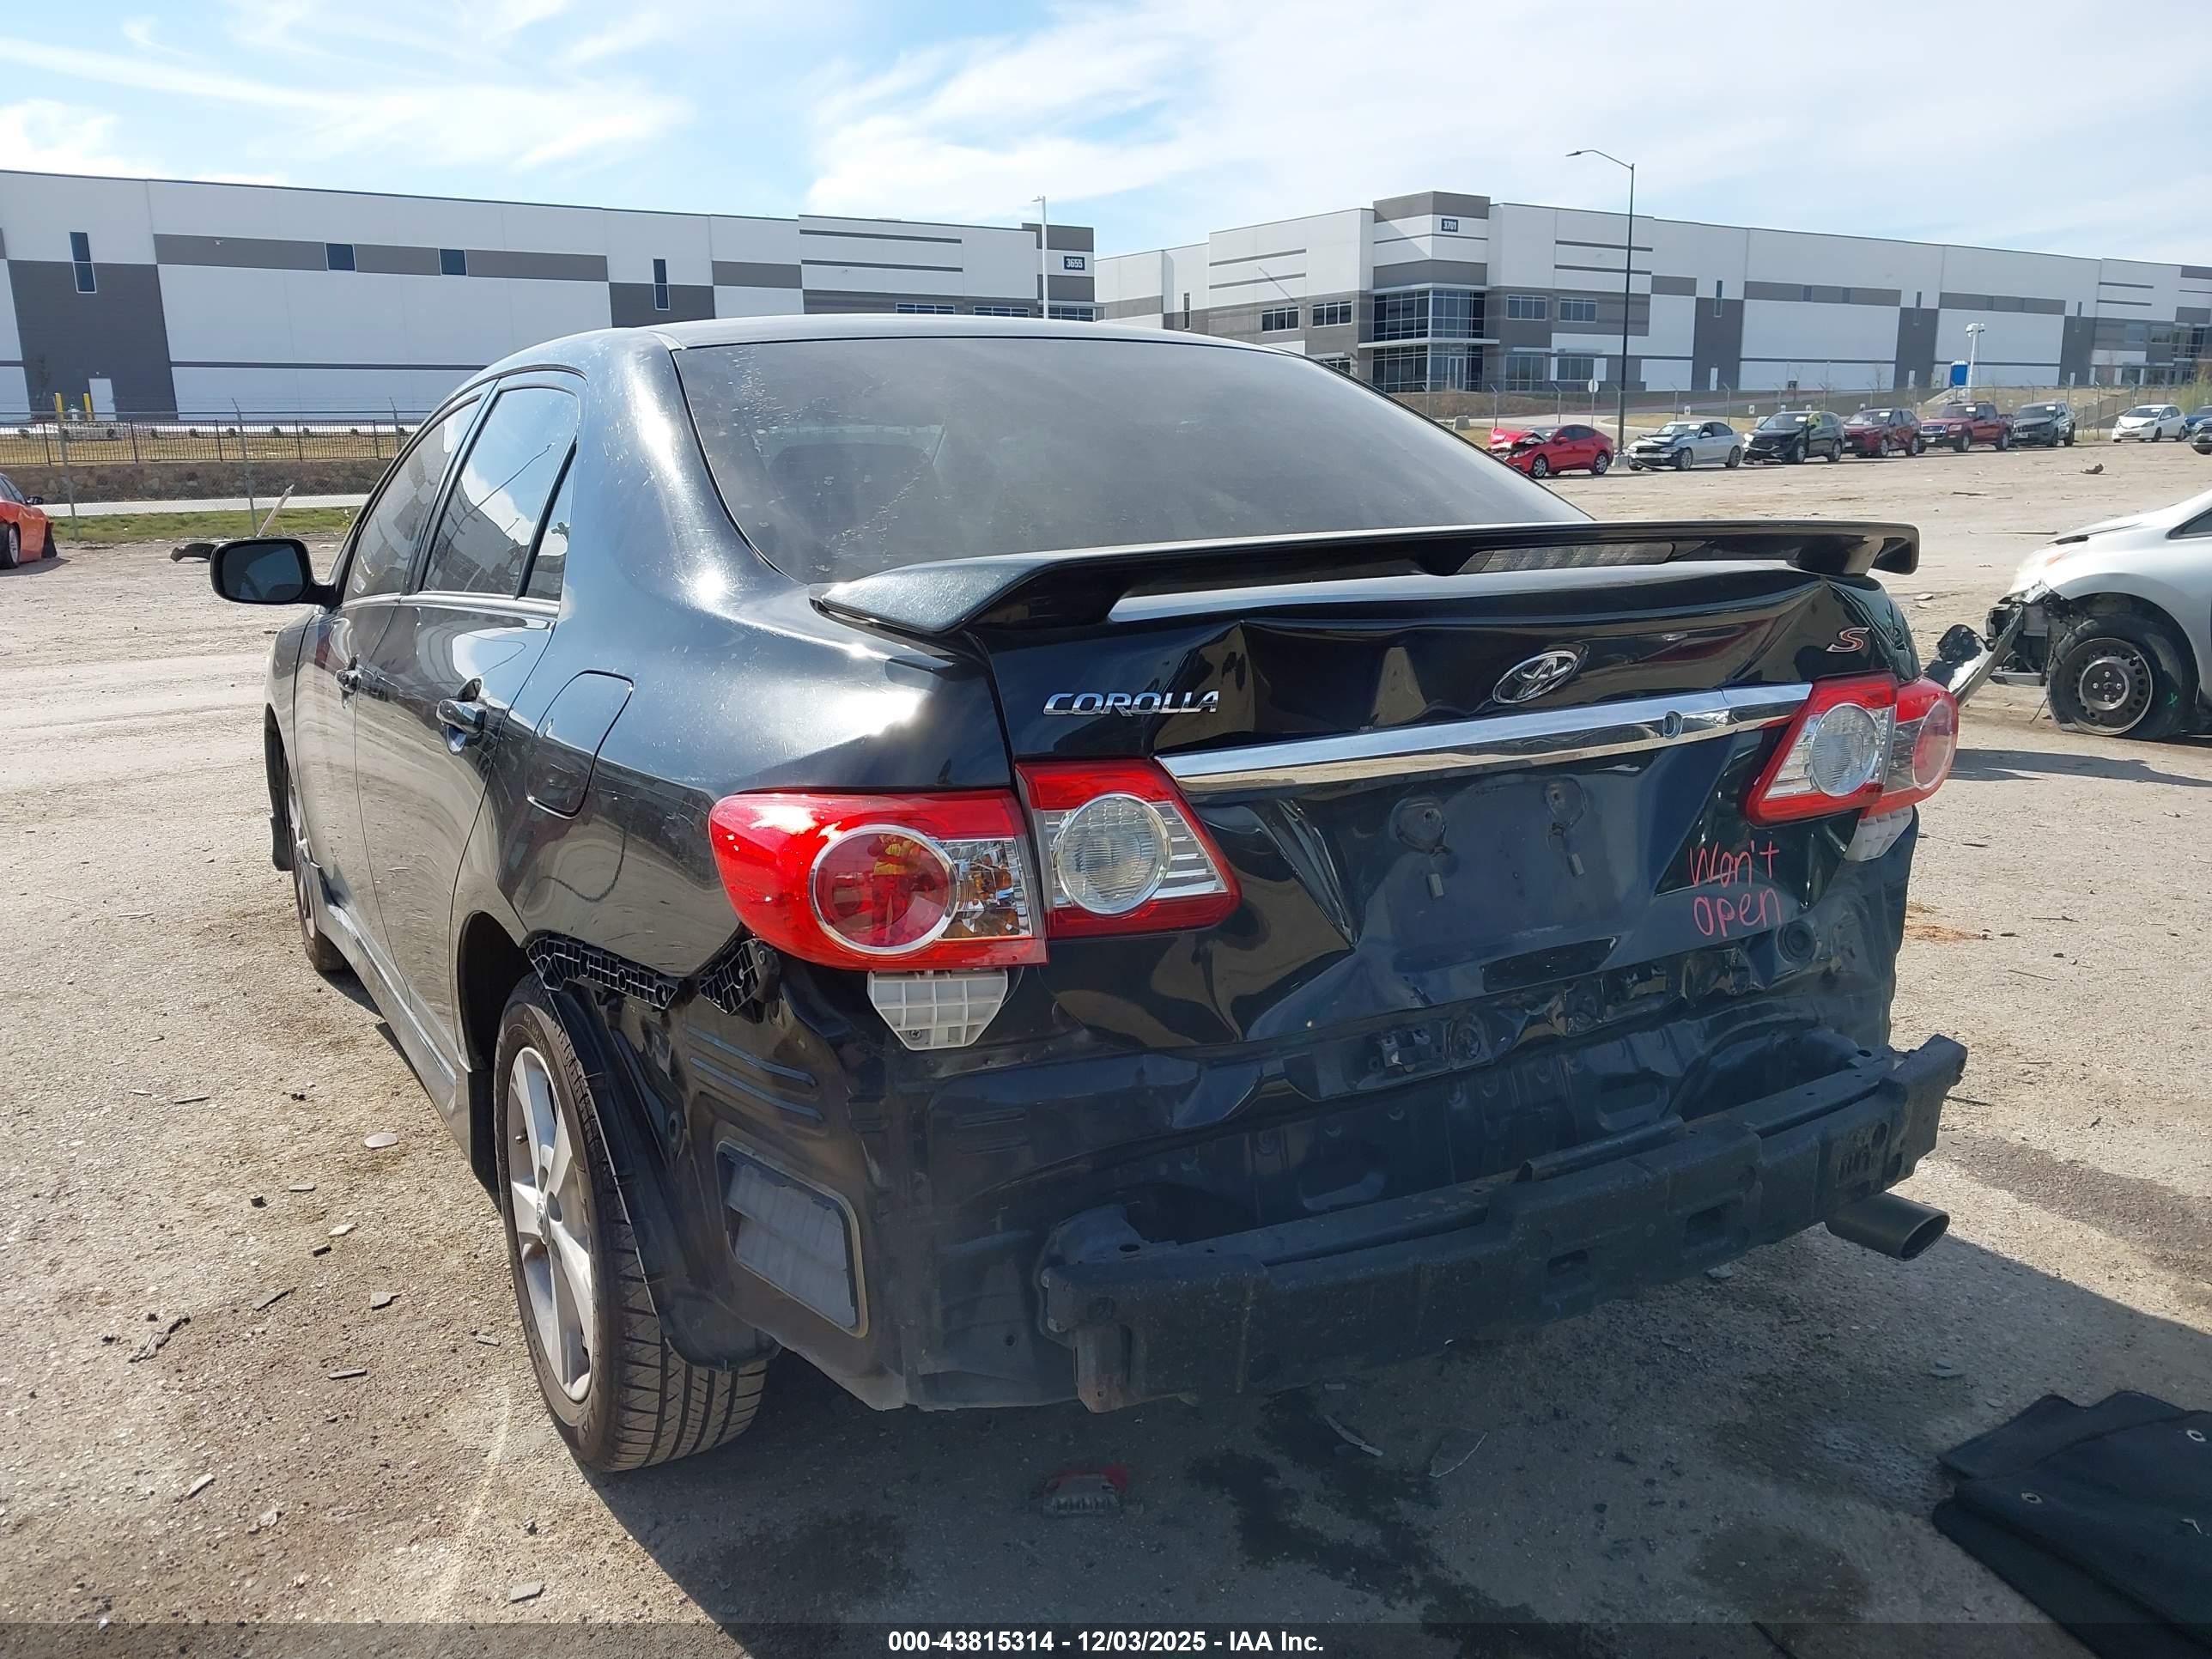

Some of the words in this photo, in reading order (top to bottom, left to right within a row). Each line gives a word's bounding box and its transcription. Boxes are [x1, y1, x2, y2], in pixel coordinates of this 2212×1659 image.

[1066, 258, 1084, 269] 3655
[1826, 627, 1869, 653] S
[1043, 690, 1219, 717] COROLLA
[1693, 887, 1782, 937] open
